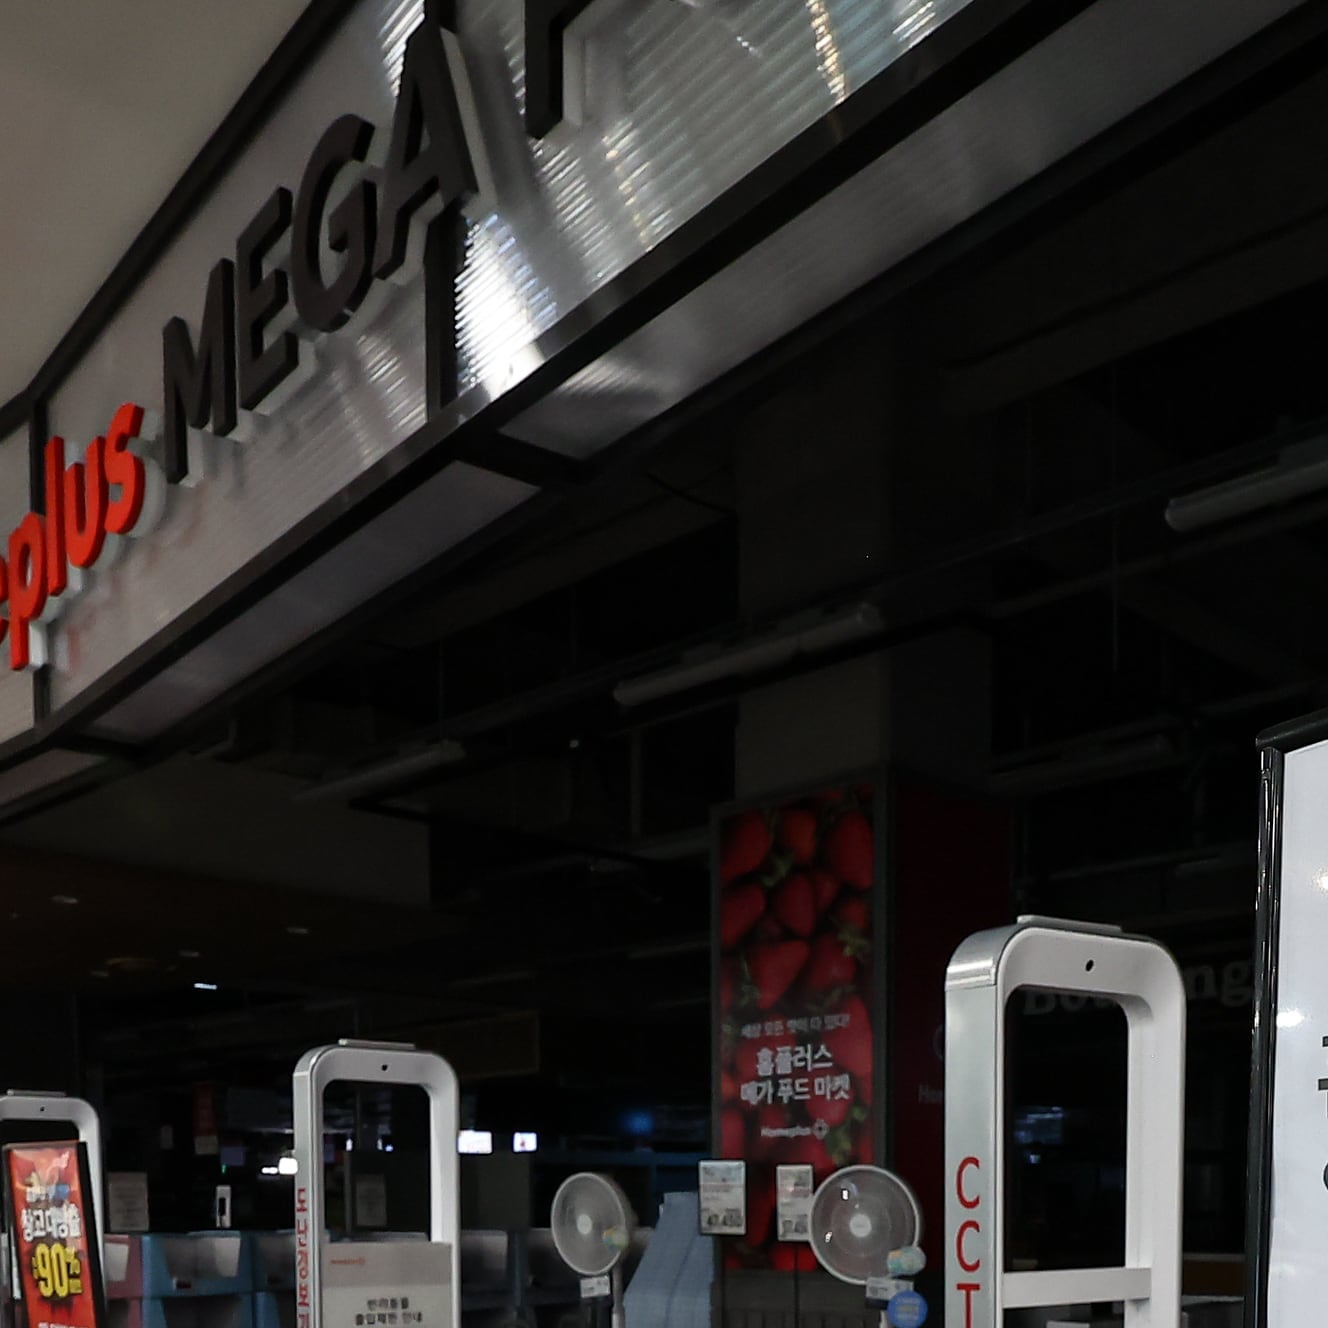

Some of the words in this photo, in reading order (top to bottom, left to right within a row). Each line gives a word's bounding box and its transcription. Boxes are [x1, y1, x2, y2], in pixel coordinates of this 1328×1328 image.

[162, 17, 479, 486] MEGA
[756, 1043, 833, 1077] 홈플러스
[777, 1077, 811, 1104] 푸드
[813, 1073, 851, 1101] 마켓
